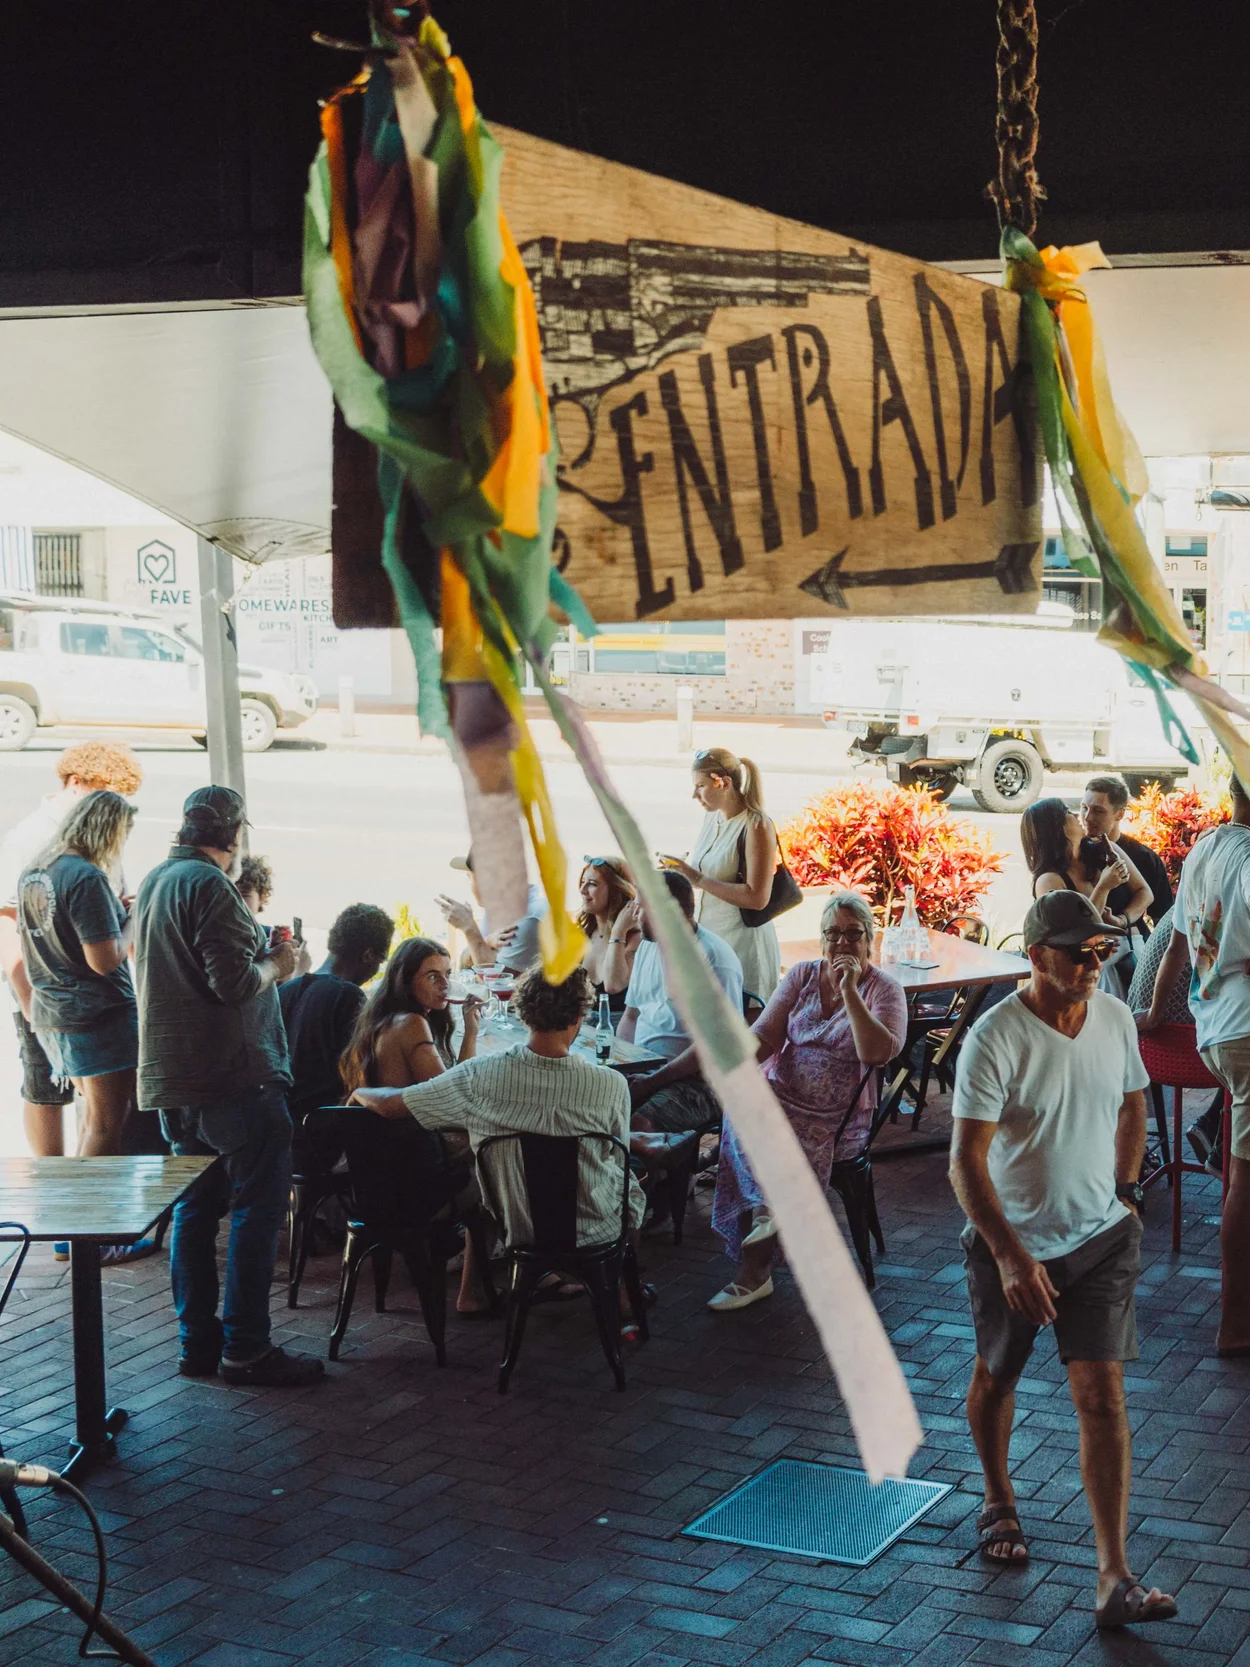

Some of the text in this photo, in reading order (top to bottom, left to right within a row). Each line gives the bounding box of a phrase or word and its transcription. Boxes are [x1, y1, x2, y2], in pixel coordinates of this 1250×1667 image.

[609, 271, 1037, 620] ENTRADA
[150, 589, 192, 604] FAVE
[258, 621, 293, 632] GIFTS
